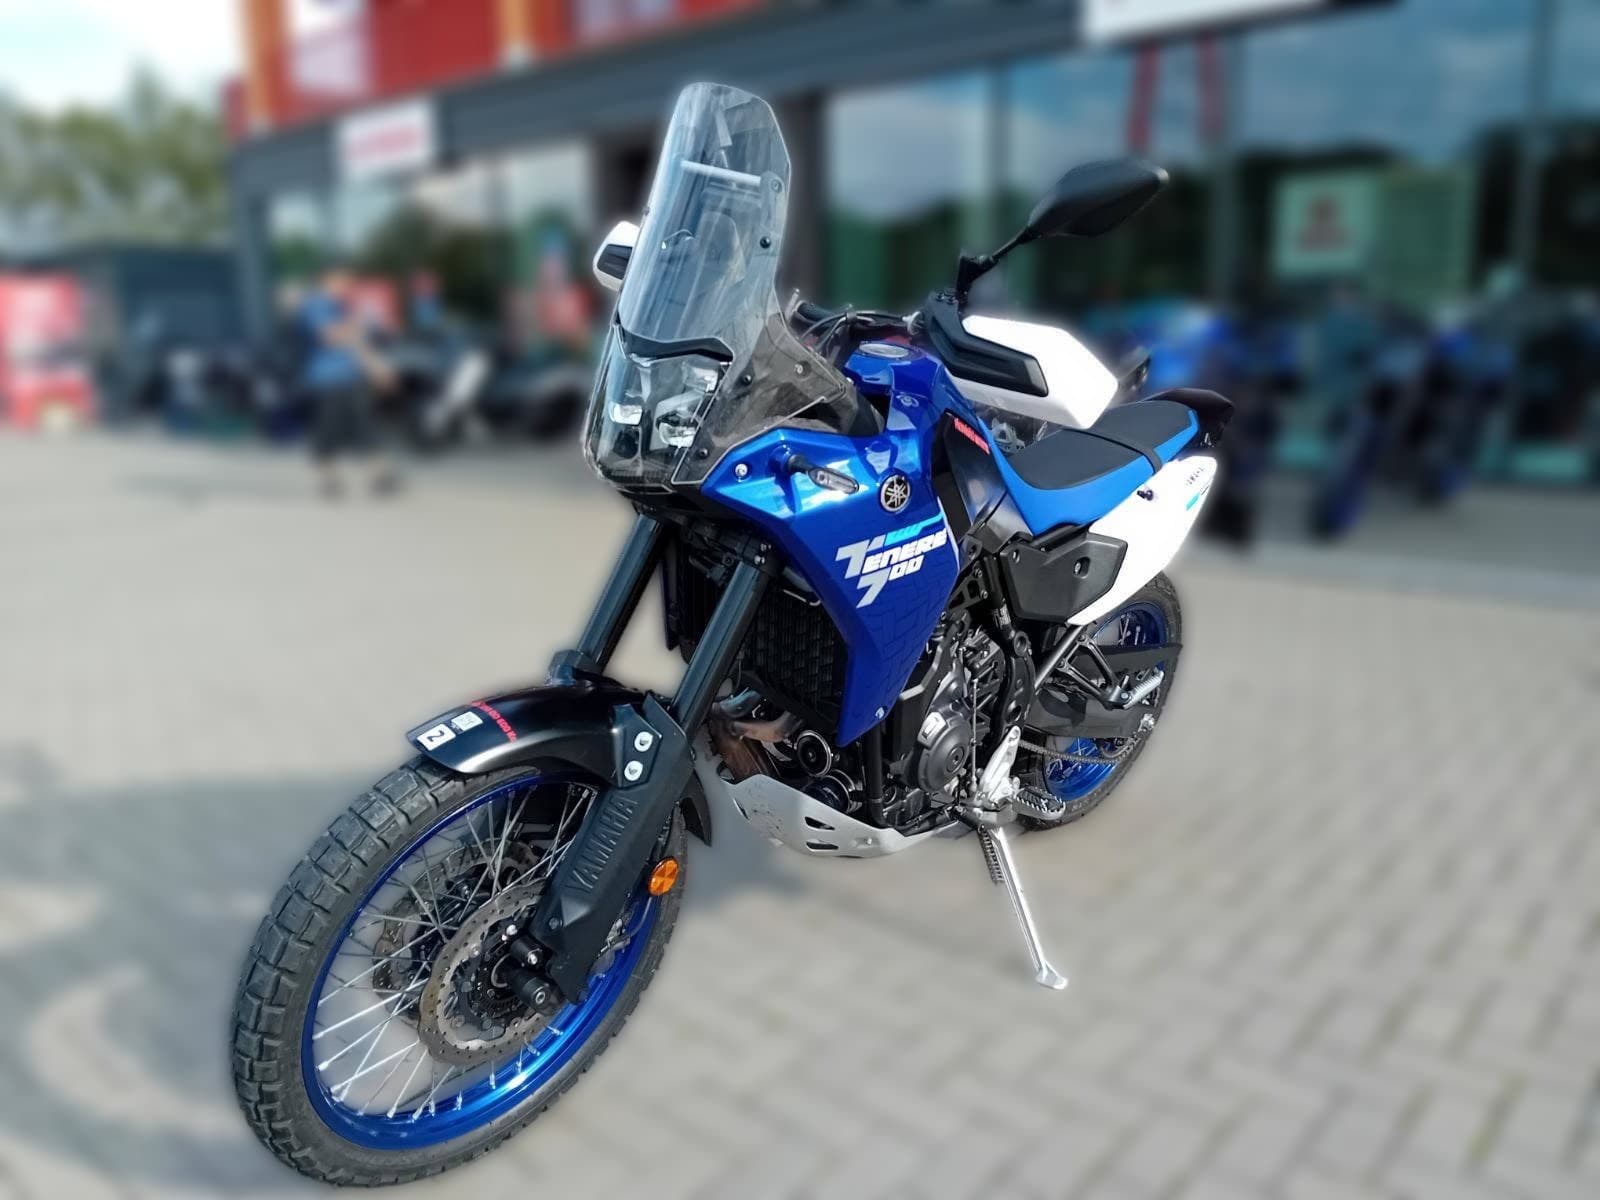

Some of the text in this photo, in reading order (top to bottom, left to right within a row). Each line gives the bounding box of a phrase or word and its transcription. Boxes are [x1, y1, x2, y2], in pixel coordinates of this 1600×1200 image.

[855, 555, 924, 609] 700
[427, 730, 445, 743] 2
[564, 795, 638, 895] YAMAHA
